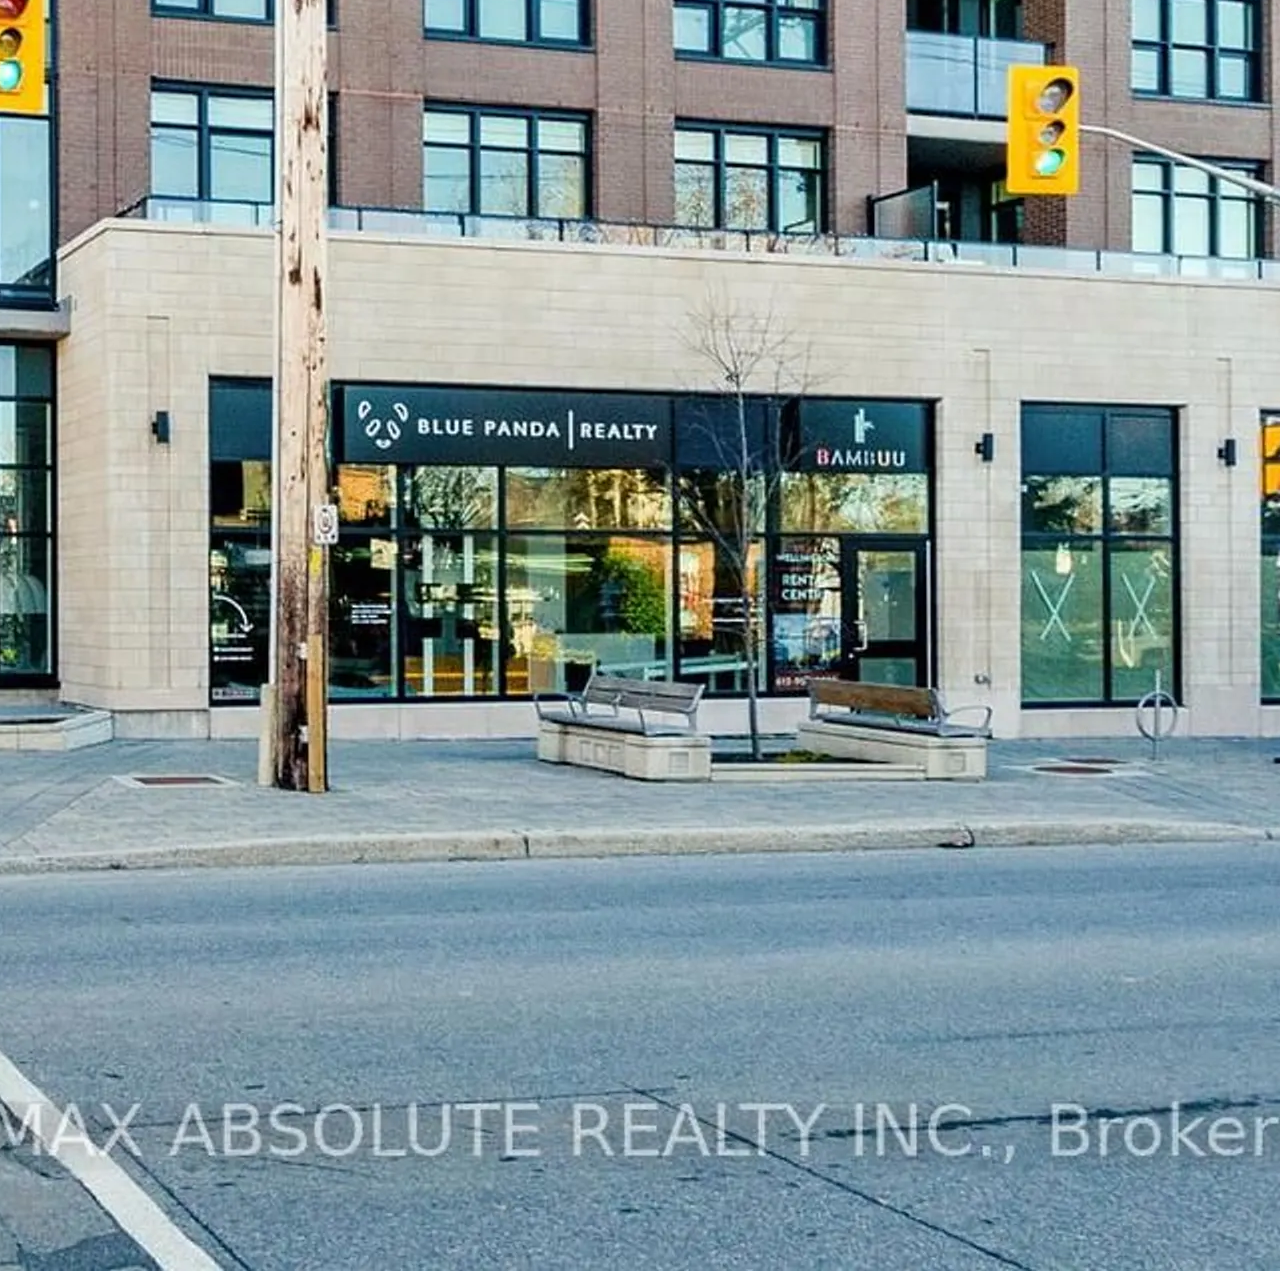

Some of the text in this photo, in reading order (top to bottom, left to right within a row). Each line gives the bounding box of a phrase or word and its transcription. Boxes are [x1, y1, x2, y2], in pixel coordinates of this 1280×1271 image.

[417, 418, 658, 440] BLUE PANDA REALTY
